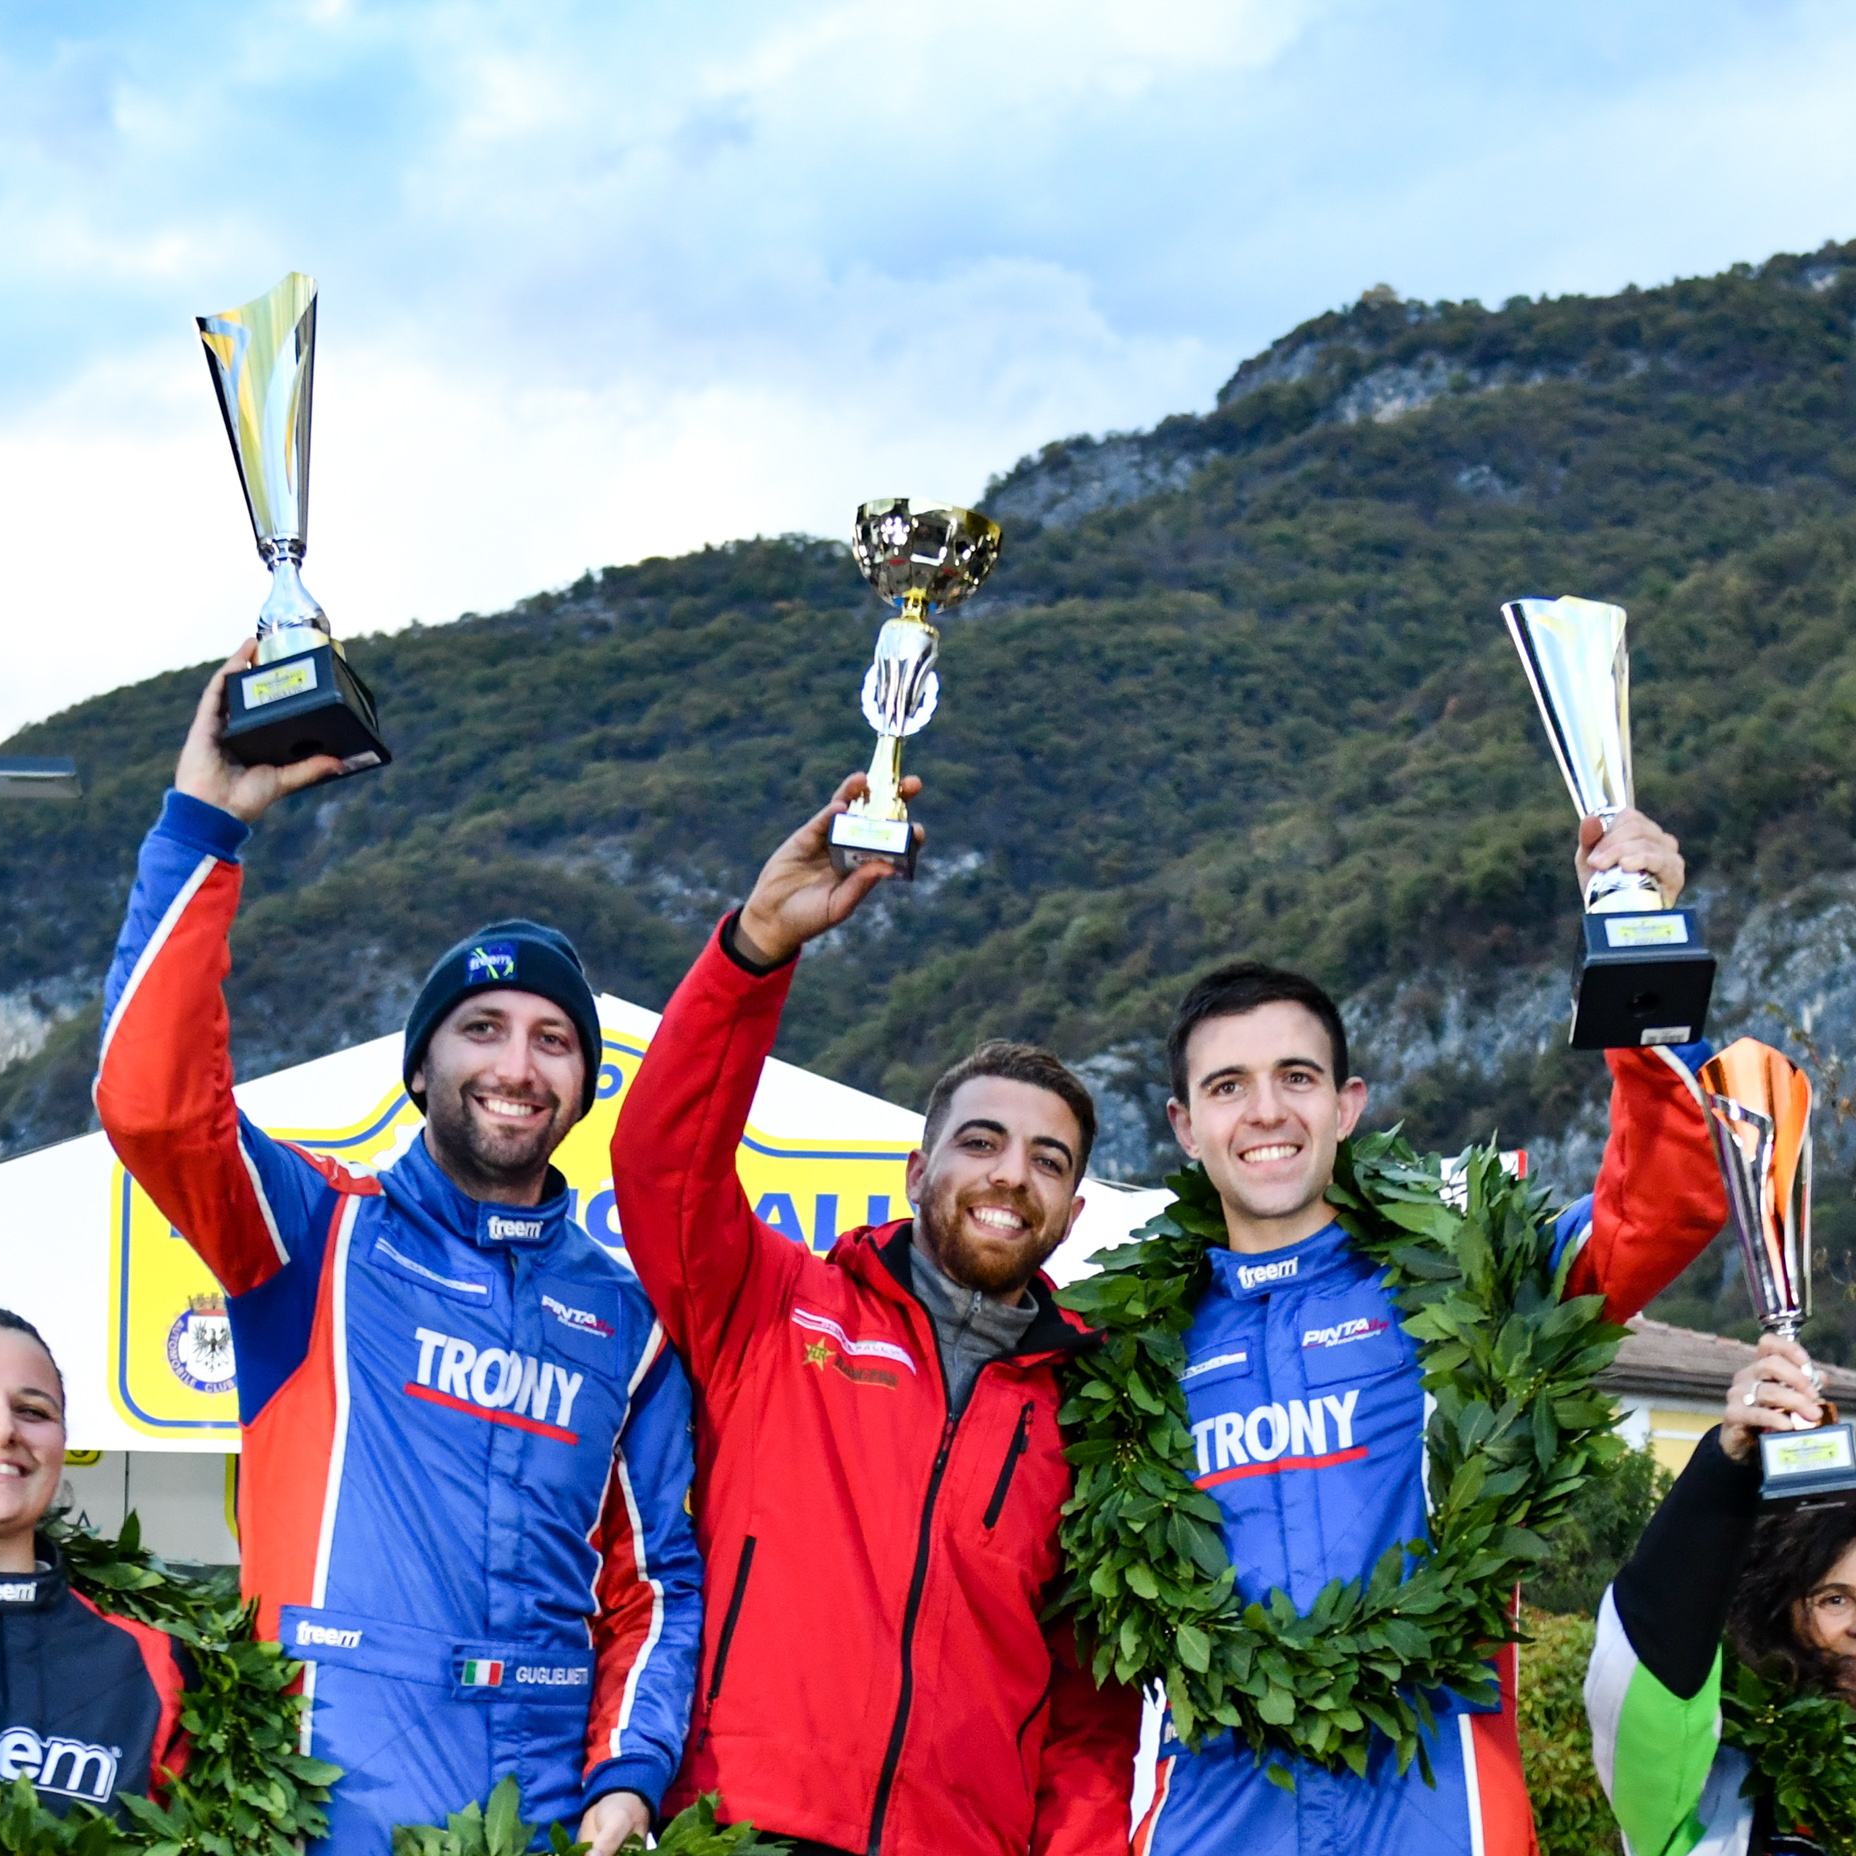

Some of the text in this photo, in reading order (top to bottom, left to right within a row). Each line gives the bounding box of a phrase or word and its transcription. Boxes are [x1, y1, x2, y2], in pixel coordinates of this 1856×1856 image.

[487, 1215, 544, 1240] freem
[1237, 1257, 1298, 1290] freem
[168, 1319, 235, 1394] AUTOMOBILE CLUB
[415, 1327, 584, 1428] TRONY
[1191, 1390, 1360, 1476] TRONY
[296, 1620, 363, 1648] freem
